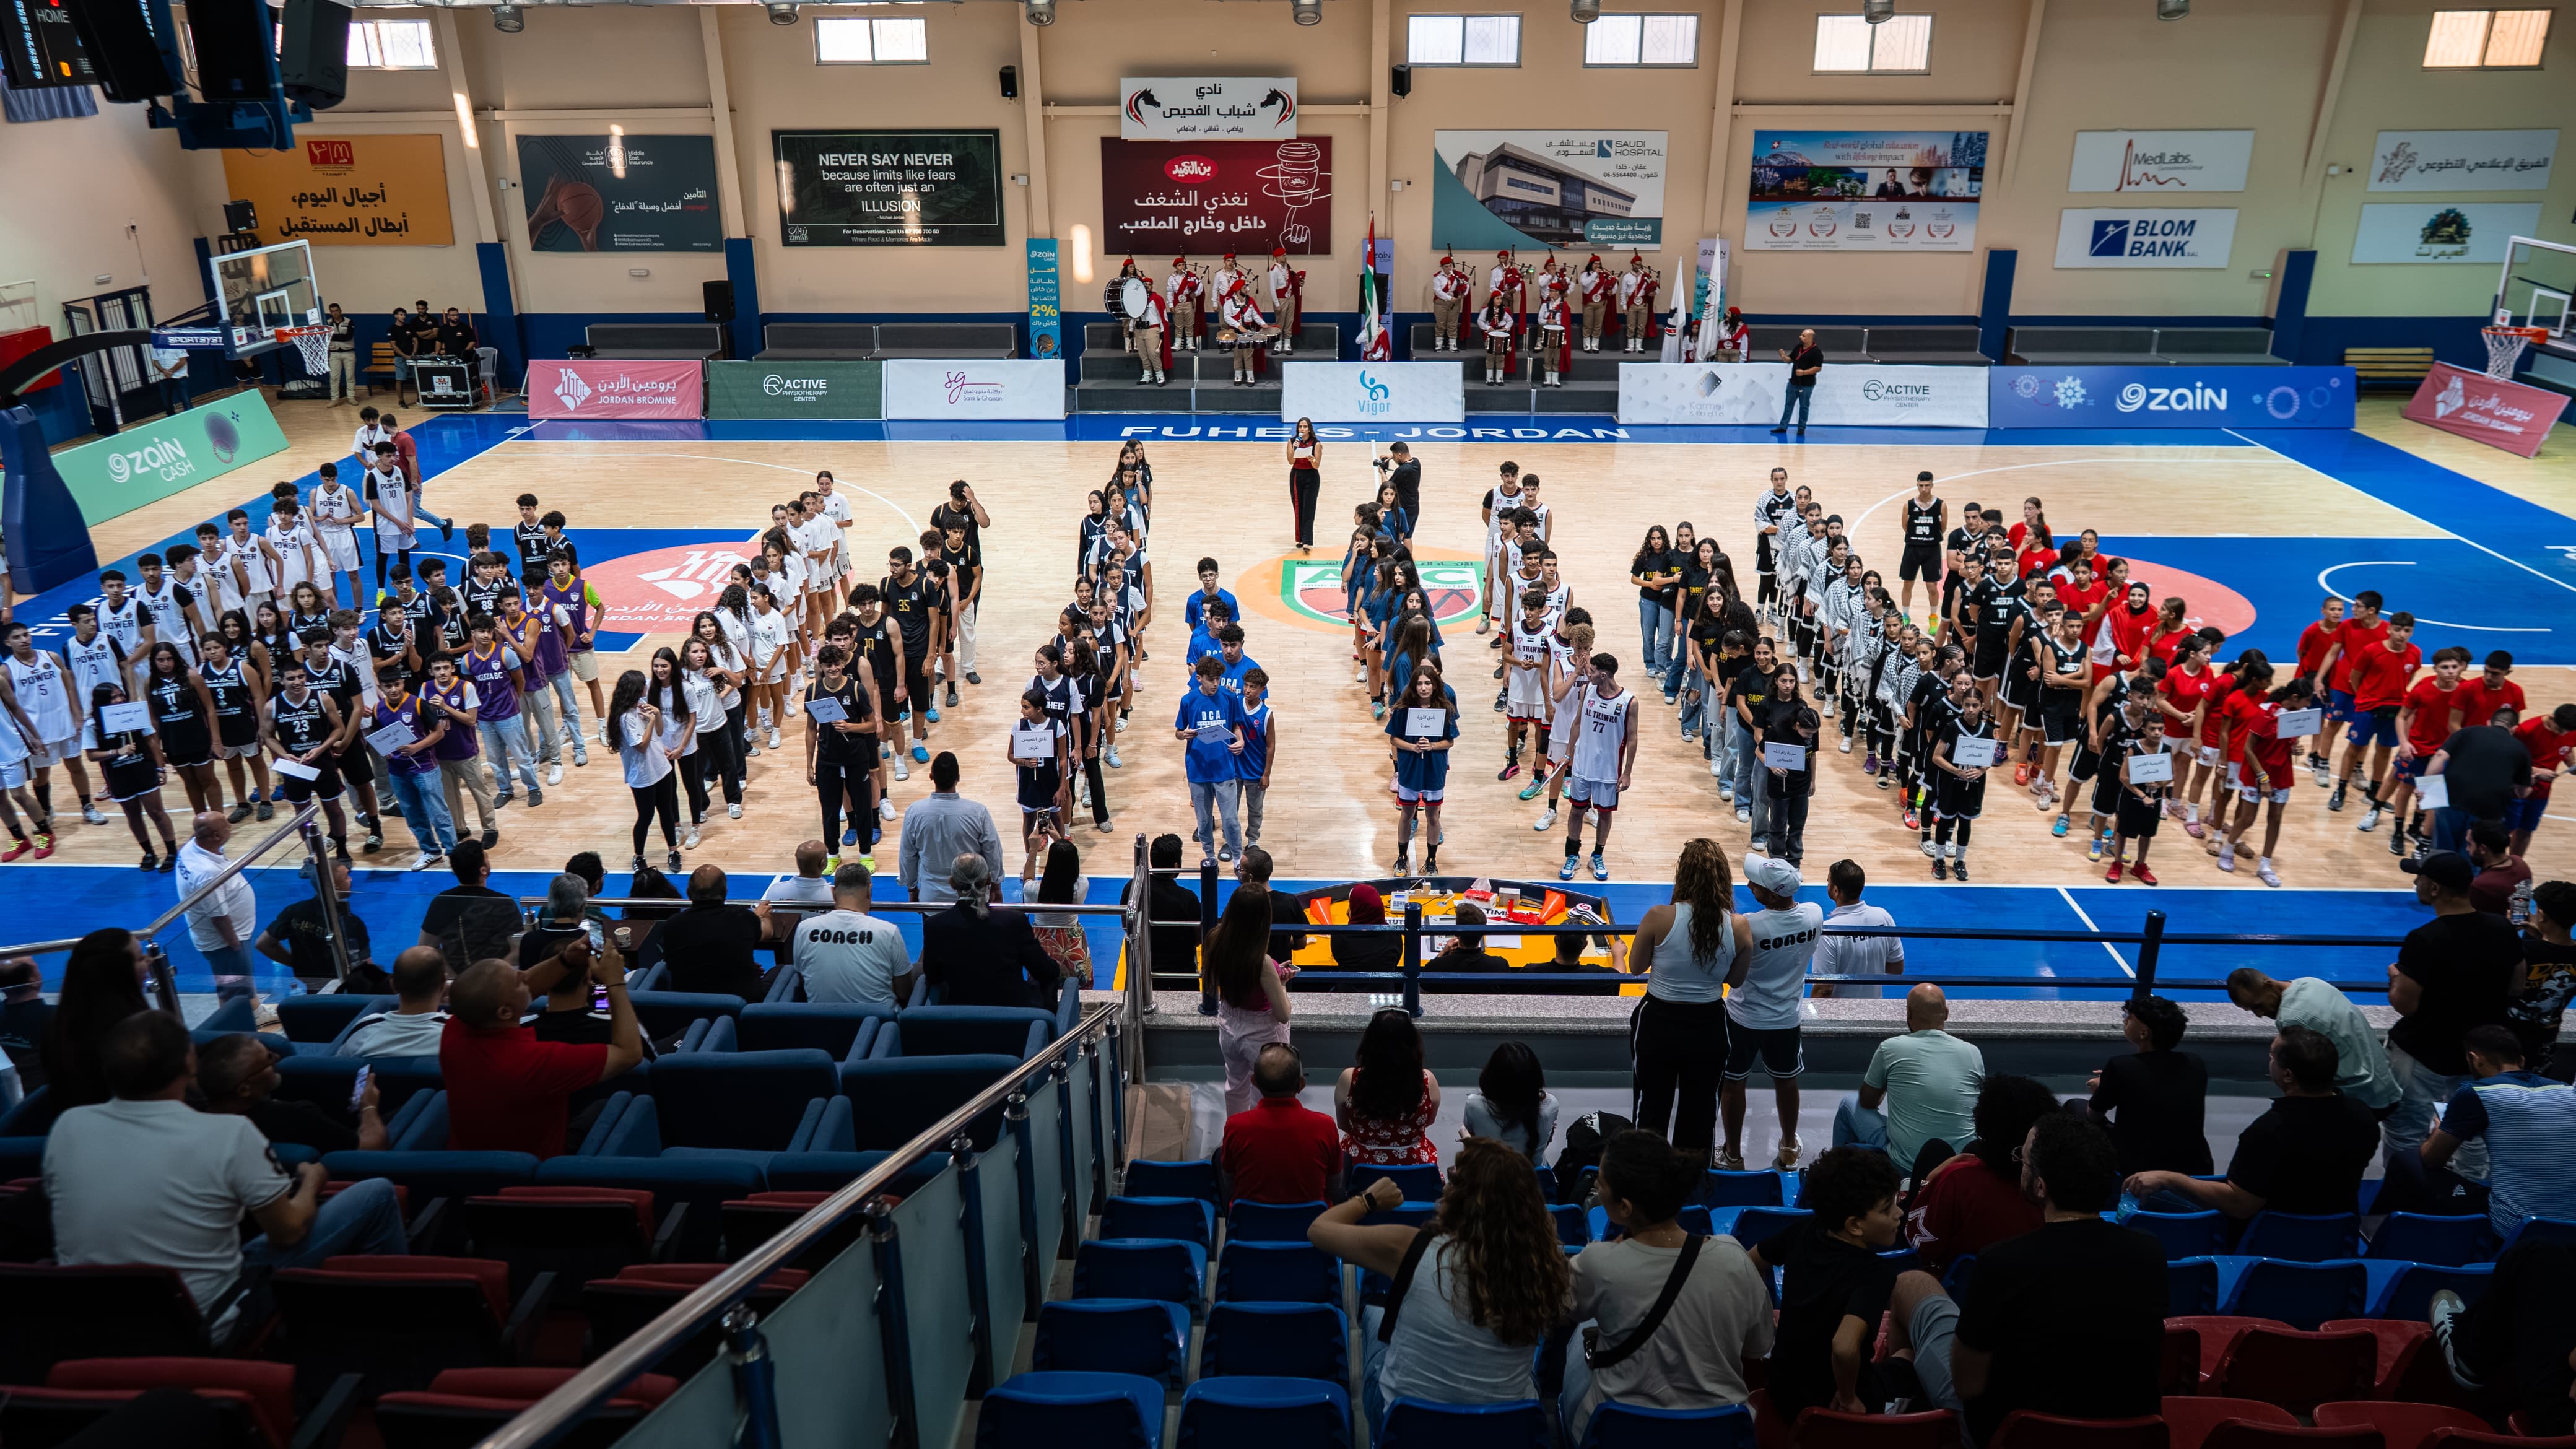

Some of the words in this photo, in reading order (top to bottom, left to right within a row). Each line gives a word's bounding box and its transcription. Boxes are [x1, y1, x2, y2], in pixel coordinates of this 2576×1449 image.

[36, 9, 70, 24] HOME
[1196, 83, 1222, 100] نادي
[1163, 105, 1210, 118] الفحيص
[1217, 103, 1256, 119] شباب
[1204, 125, 1219, 133] ثقافي
[1860, 141, 1884, 150] global
[1885, 141, 1919, 149] education
[1615, 149, 1664, 157] HOSPITAL
[1835, 152, 1852, 160] with
[1878, 153, 1905, 162] impact
[819, 154, 867, 166] NEVER
[872, 154, 899, 166] SAY
[903, 154, 953, 166] NEVER
[822, 170, 870, 181] because
[873, 169, 903, 180] limits
[905, 169, 925, 180] like
[928, 169, 956, 180] fears
[683, 188, 707, 199] التأمين
[845, 184, 863, 193] are
[866, 182, 894, 193] often
[897, 182, 918, 194] just
[921, 184, 934, 193] an
[292, 187, 338, 209] اليوم،
[342, 182, 387, 207] أجيال
[1134, 189, 1198, 207] الشغف
[638, 202, 659, 212] وسيلة
[661, 200, 682, 212] أفضل
[861, 200, 921, 212] ILLUSION
[1204, 191, 1248, 214] نغذي
[279, 216, 360, 237] المستقبل
[365, 212, 409, 237] أبطال
[1119, 215, 1178, 233] الملعب.
[1184, 215, 1225, 235] وخارج
[1230, 215, 1266, 230] داخل
[2133, 220, 2197, 236] BLOM
[2128, 241, 2190, 256] BANK
[1032, 304, 1058, 317] 2%
[168, 336, 223, 344] SPORTSYST
[598, 373, 630, 393] الأردن
[632, 380, 676, 393] برومين
[784, 379, 827, 389] ACTIVE
[1886, 385, 1930, 394] ACTIVE
[598, 396, 634, 404] JORDAN
[637, 396, 676, 404] BROMINE
[2147, 381, 2228, 411] zain
[1357, 399, 1391, 415] Vigor
[1689, 401, 1724, 410] Karmel
[1120, 426, 1355, 438] FUHES
[1395, 426, 1631, 438] JORDAN
[160, 459, 196, 482] CASH
[389, 490, 396, 498] 10
[1916, 526, 1930, 535] 24
[274, 542, 297, 550] POWER
[530, 539, 536, 549] 8
[282, 550, 288, 559] 6
[820, 580, 829, 588] 33
[147, 603, 170, 611] OWER
[481, 599, 494, 611] 88
[898, 599, 910, 612] 35
[1997, 608, 2008, 619] 11
[103, 619, 134, 630] POWER
[116, 630, 123, 640] 8
[76, 652, 108, 665] POWER
[92, 664, 99, 675] 3
[19, 671, 56, 687] POWER
[1221, 677, 1237, 687] DCA
[39, 684, 48, 696] 5
[217, 688, 225, 699] 3
[487, 682, 492, 694] 1
[165, 693, 177, 705] 11
[1046, 701, 1066, 710] HEIS
[300, 713, 320, 721] UNITED
[1201, 710, 1221, 721] DCA
[1585, 708, 1591, 716] AL
[1593, 710, 1618, 723] THAWRA
[292, 720, 310, 733] 23
[1592, 720, 1606, 734] 77
[809, 928, 874, 945] COACH
[1759, 928, 1817, 951] COACH
